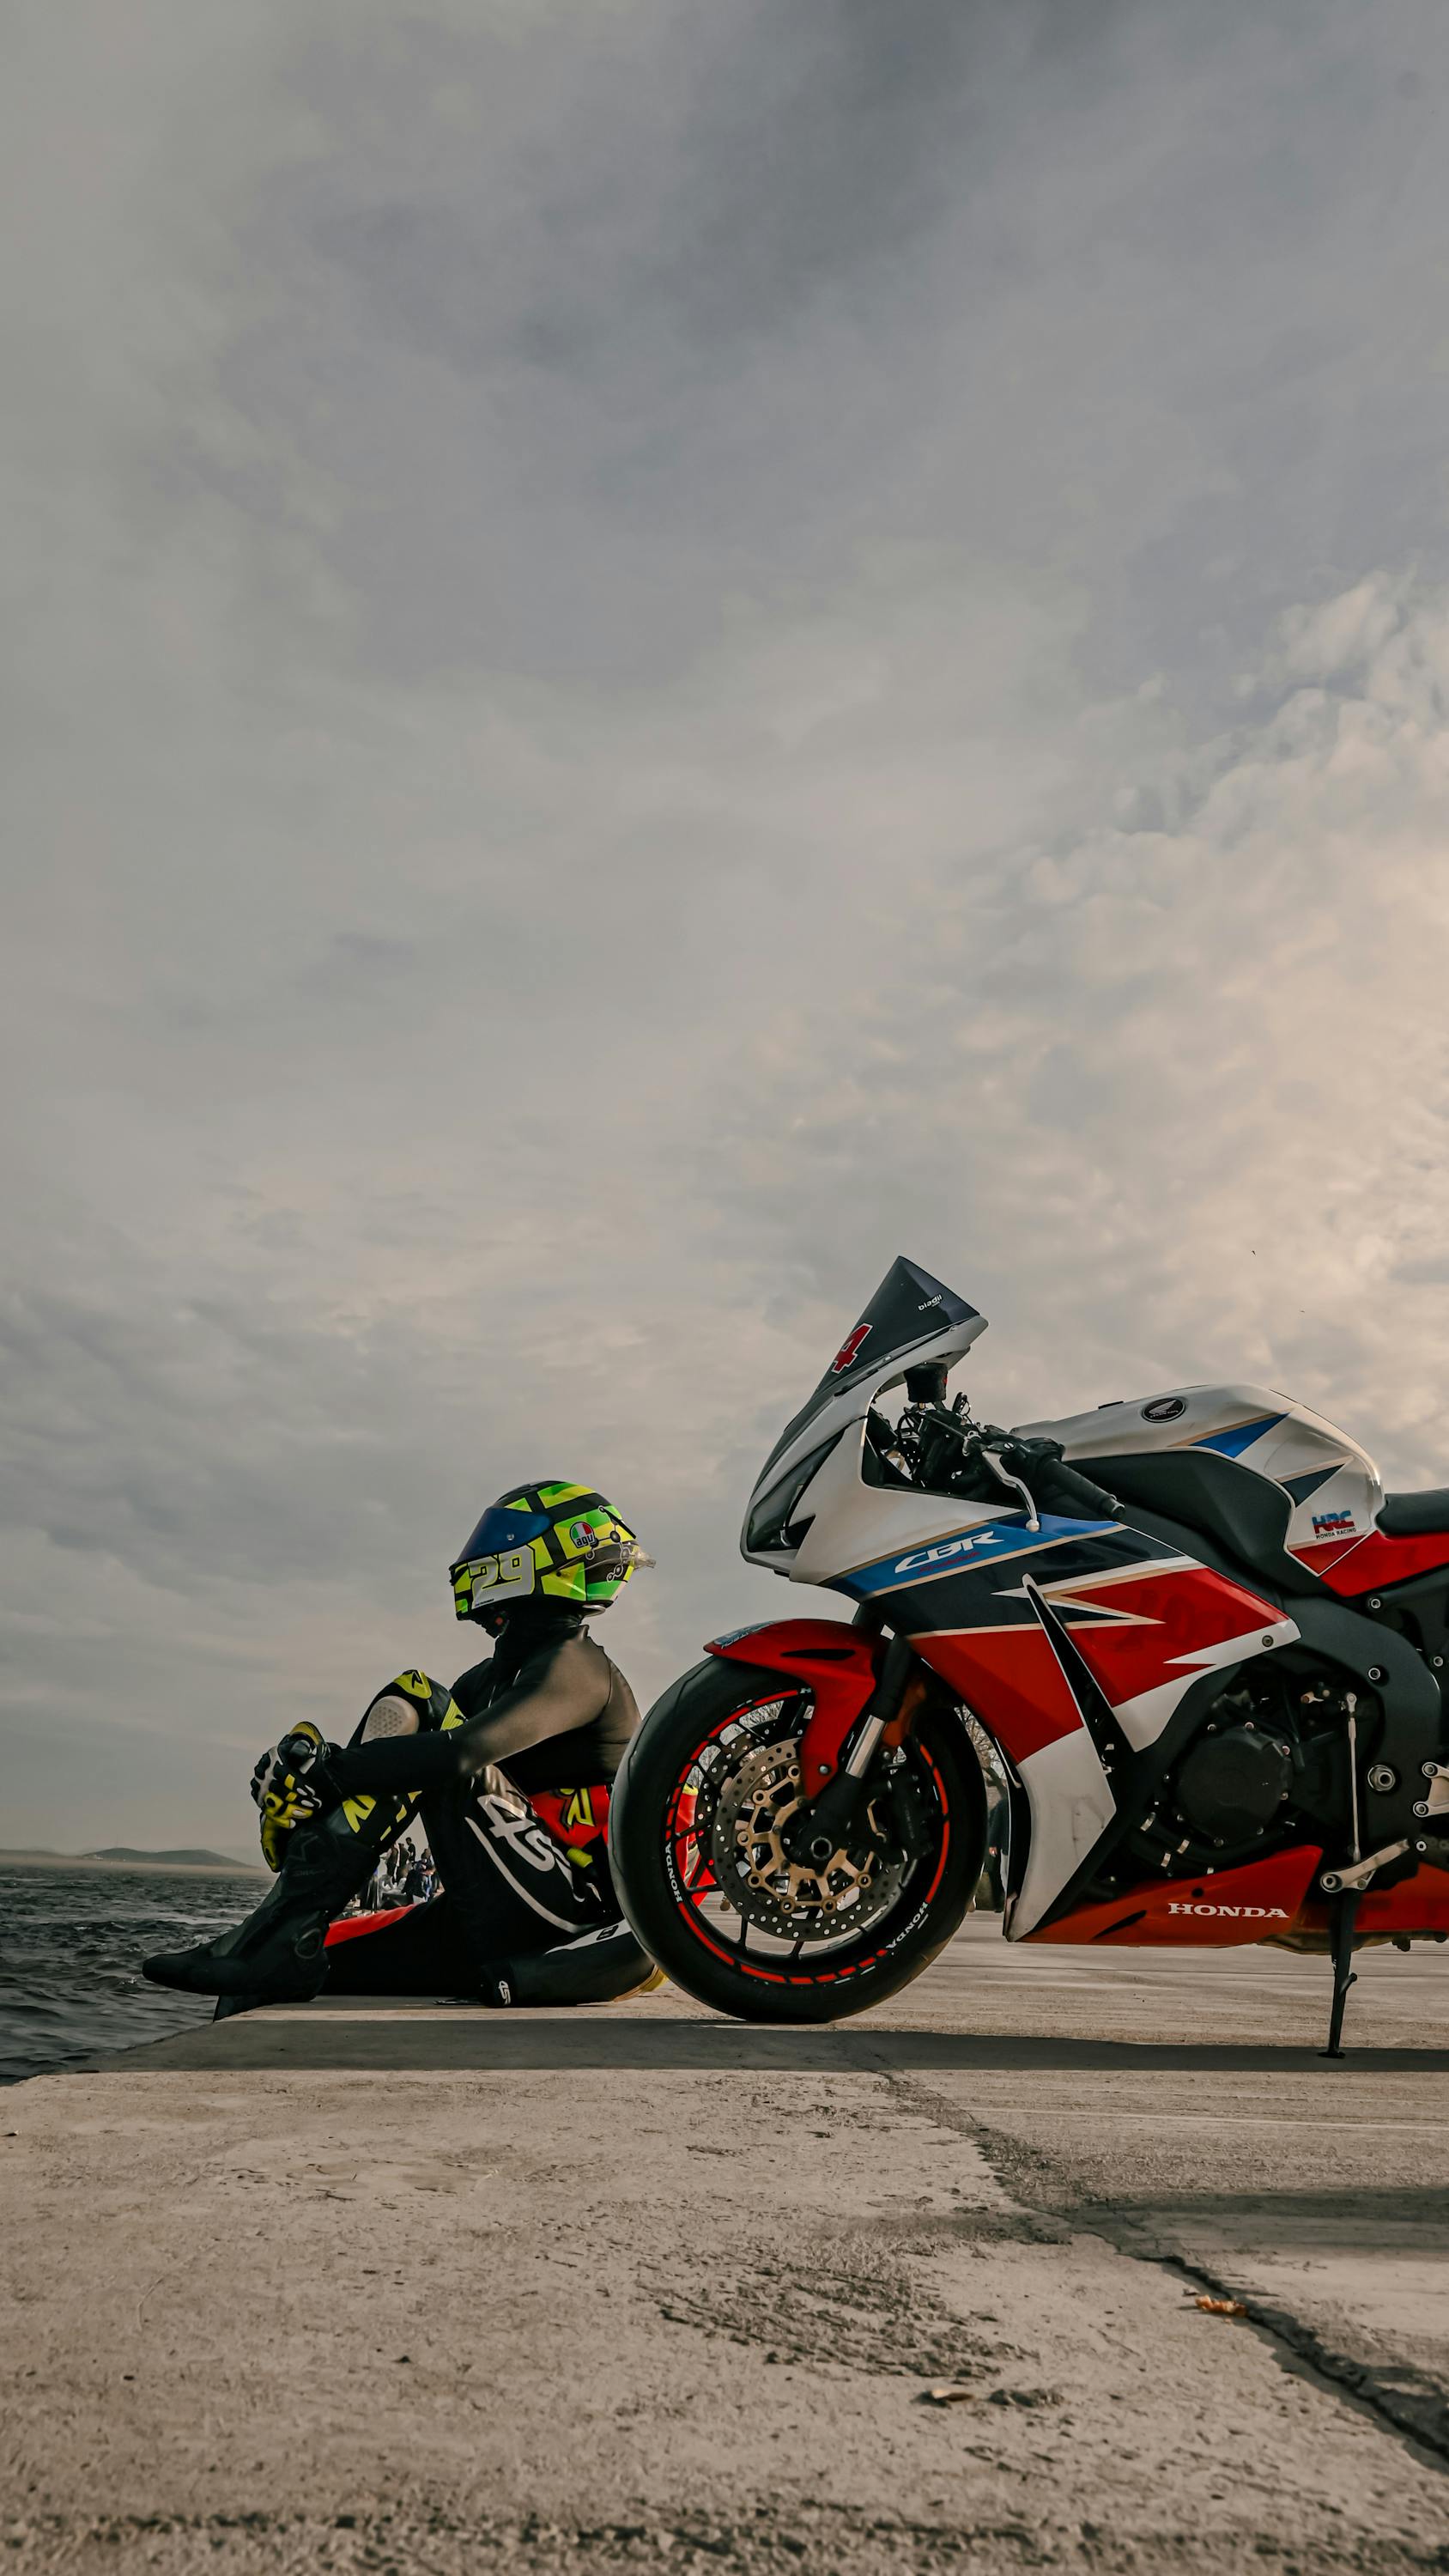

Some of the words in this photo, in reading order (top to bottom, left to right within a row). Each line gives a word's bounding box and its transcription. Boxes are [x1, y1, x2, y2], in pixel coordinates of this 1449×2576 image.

[831, 1322, 873, 1374] 4
[1312, 1510, 1355, 1534] HRC
[1336, 1528, 1356, 1536] RACING
[894, 1530, 1004, 1574] CBR
[468, 1544, 536, 1610] 29
[664, 1841, 683, 1903] HONDA
[885, 1901, 928, 1948] HONDA
[1167, 1903, 1289, 1918] HONDA
